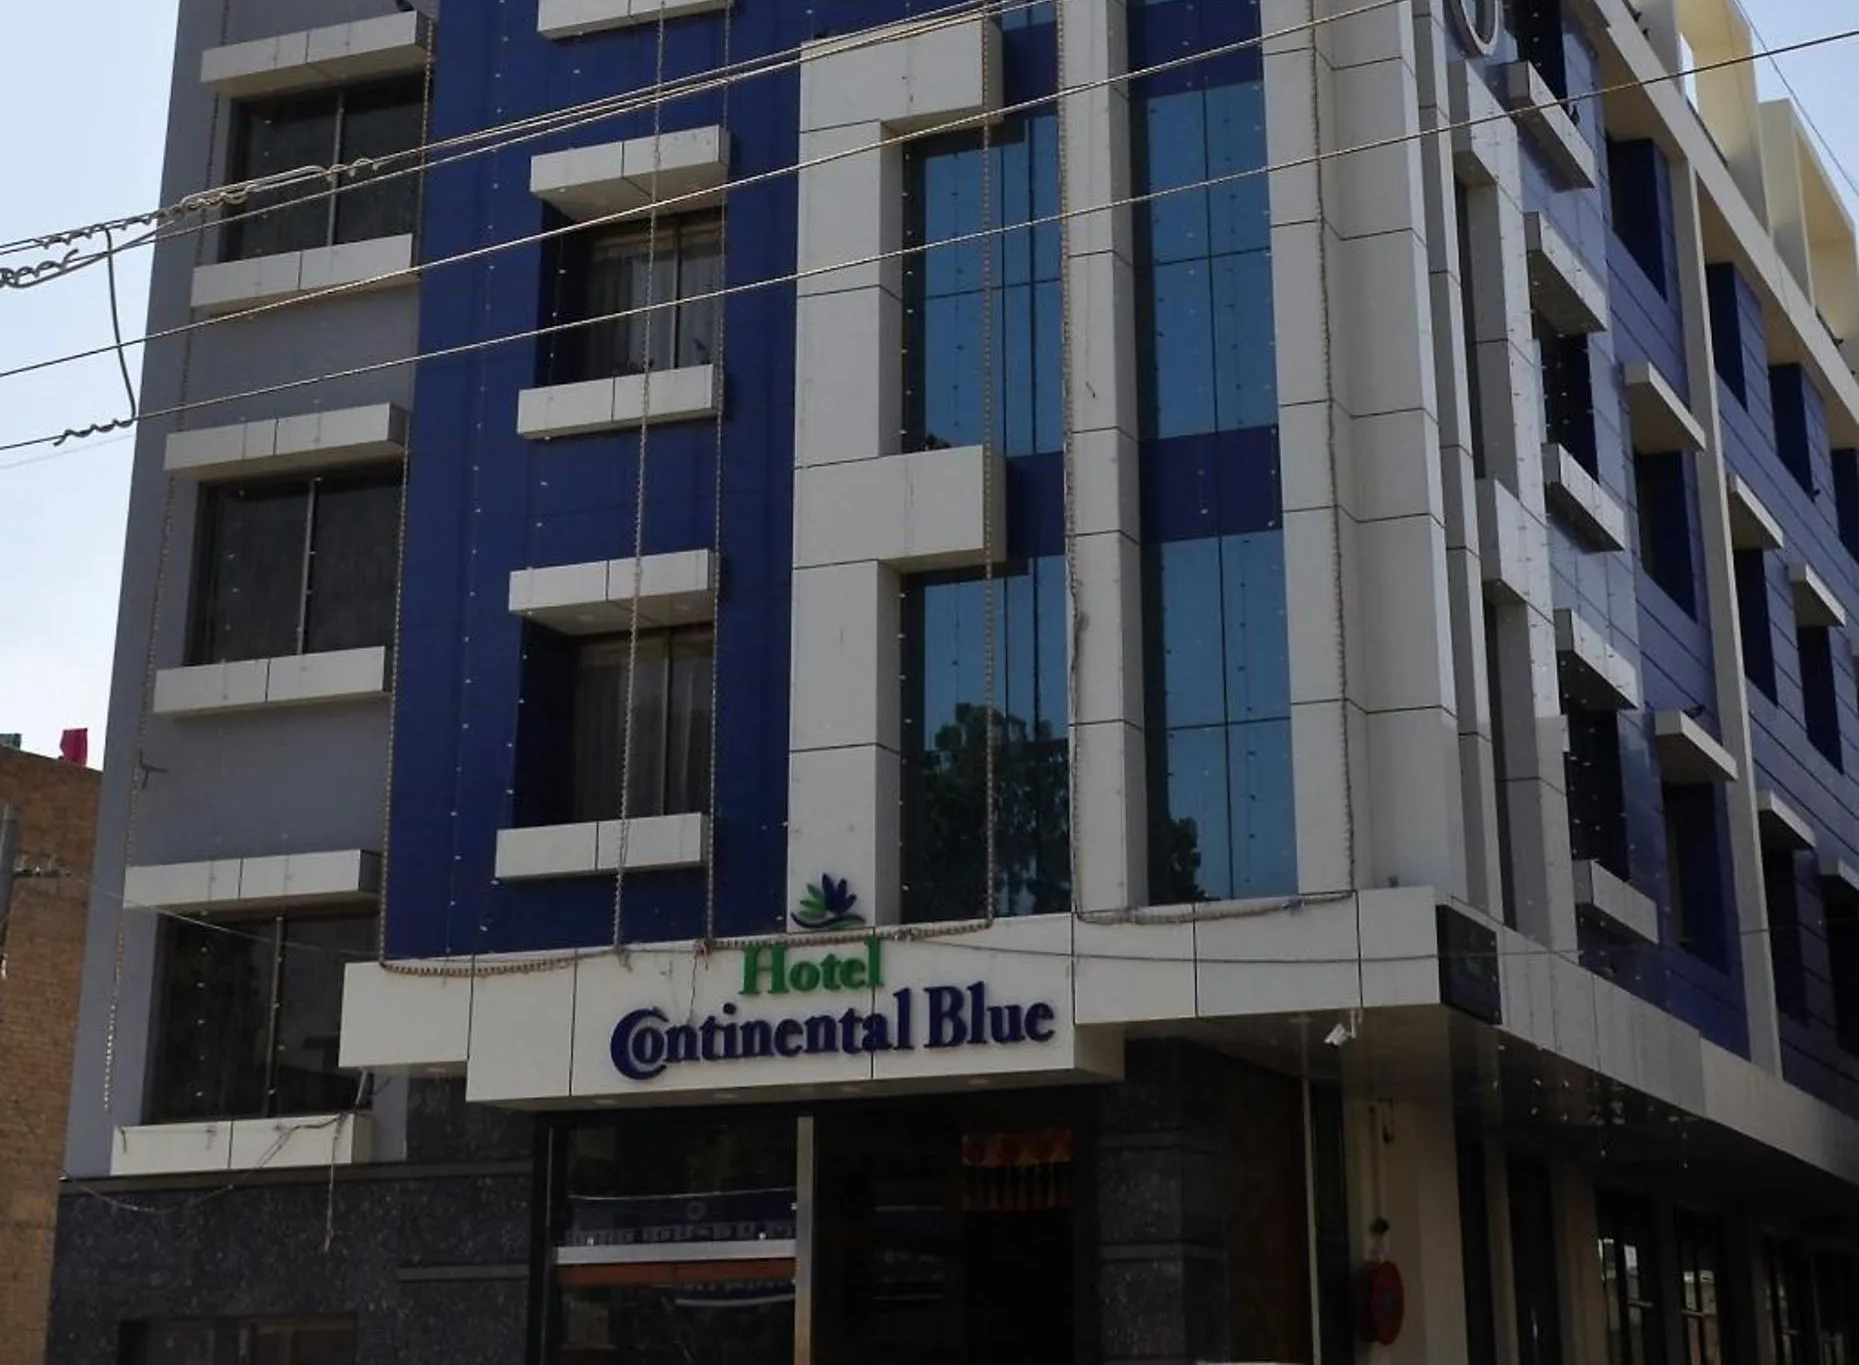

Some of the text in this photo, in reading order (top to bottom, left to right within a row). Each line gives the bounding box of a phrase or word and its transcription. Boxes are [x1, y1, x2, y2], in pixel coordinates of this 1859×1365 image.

[739, 937, 885, 996] Hotel
[611, 981, 1056, 1080] Continental Blue
